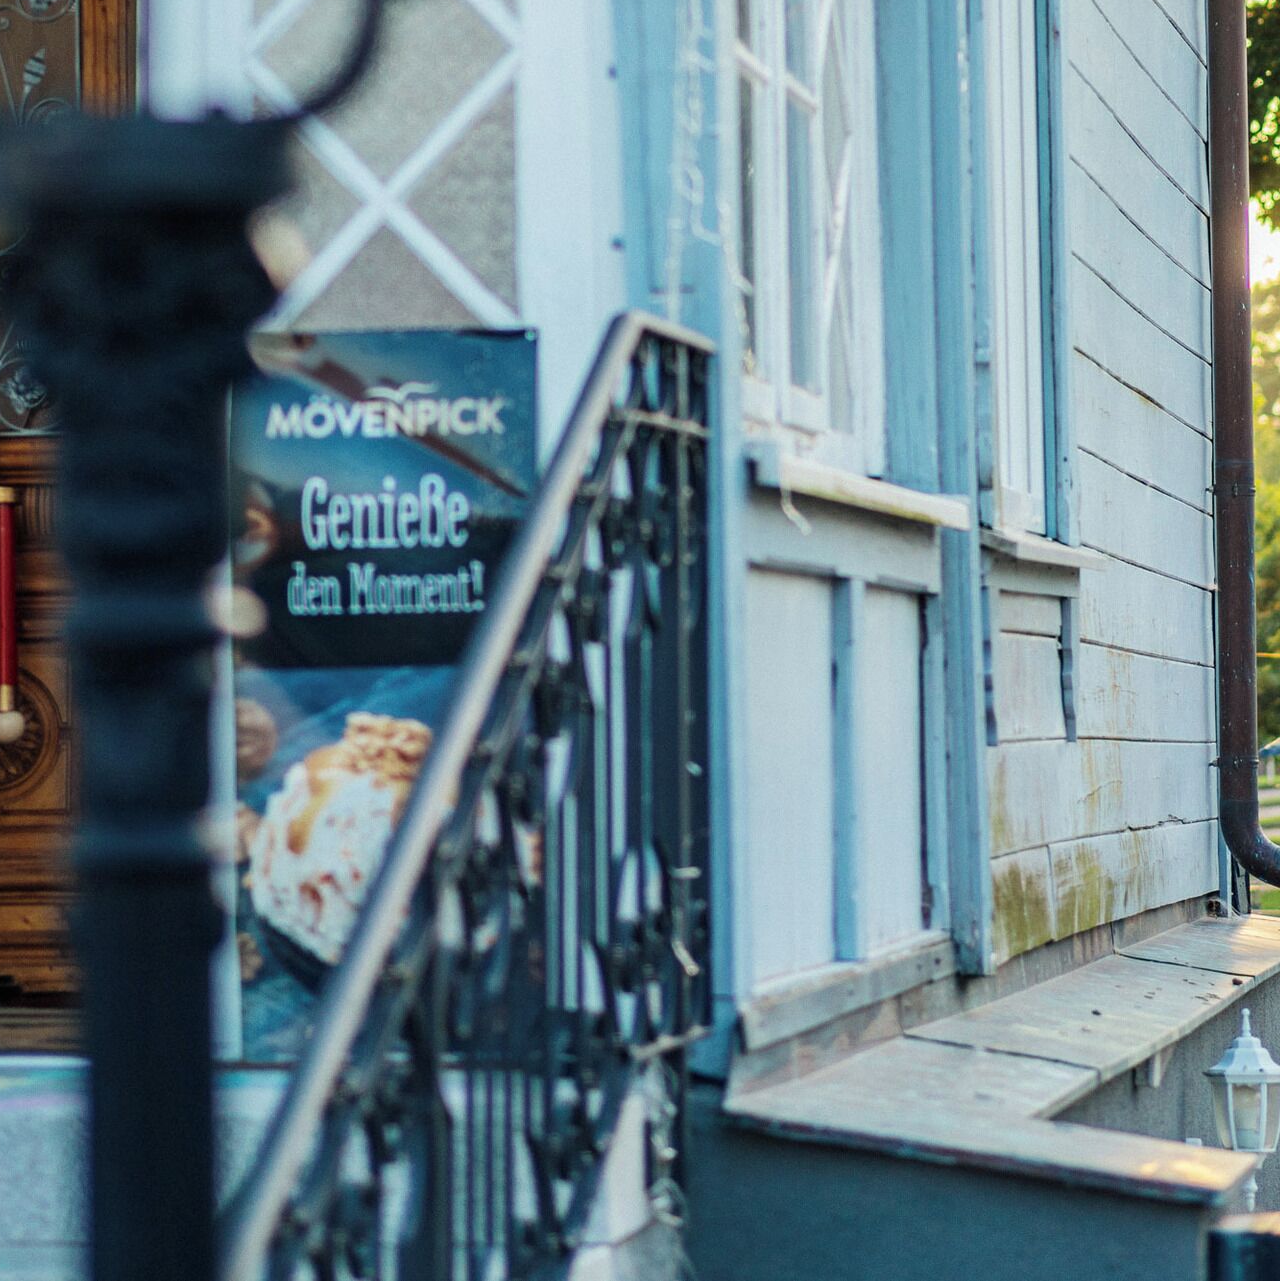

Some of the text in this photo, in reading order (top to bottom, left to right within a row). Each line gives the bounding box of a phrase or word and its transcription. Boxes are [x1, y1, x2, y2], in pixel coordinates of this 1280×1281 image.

[265, 394, 507, 439] MÖVENPICK
[301, 474, 469, 550] Genieße
[287, 559, 486, 615] den Moment!
